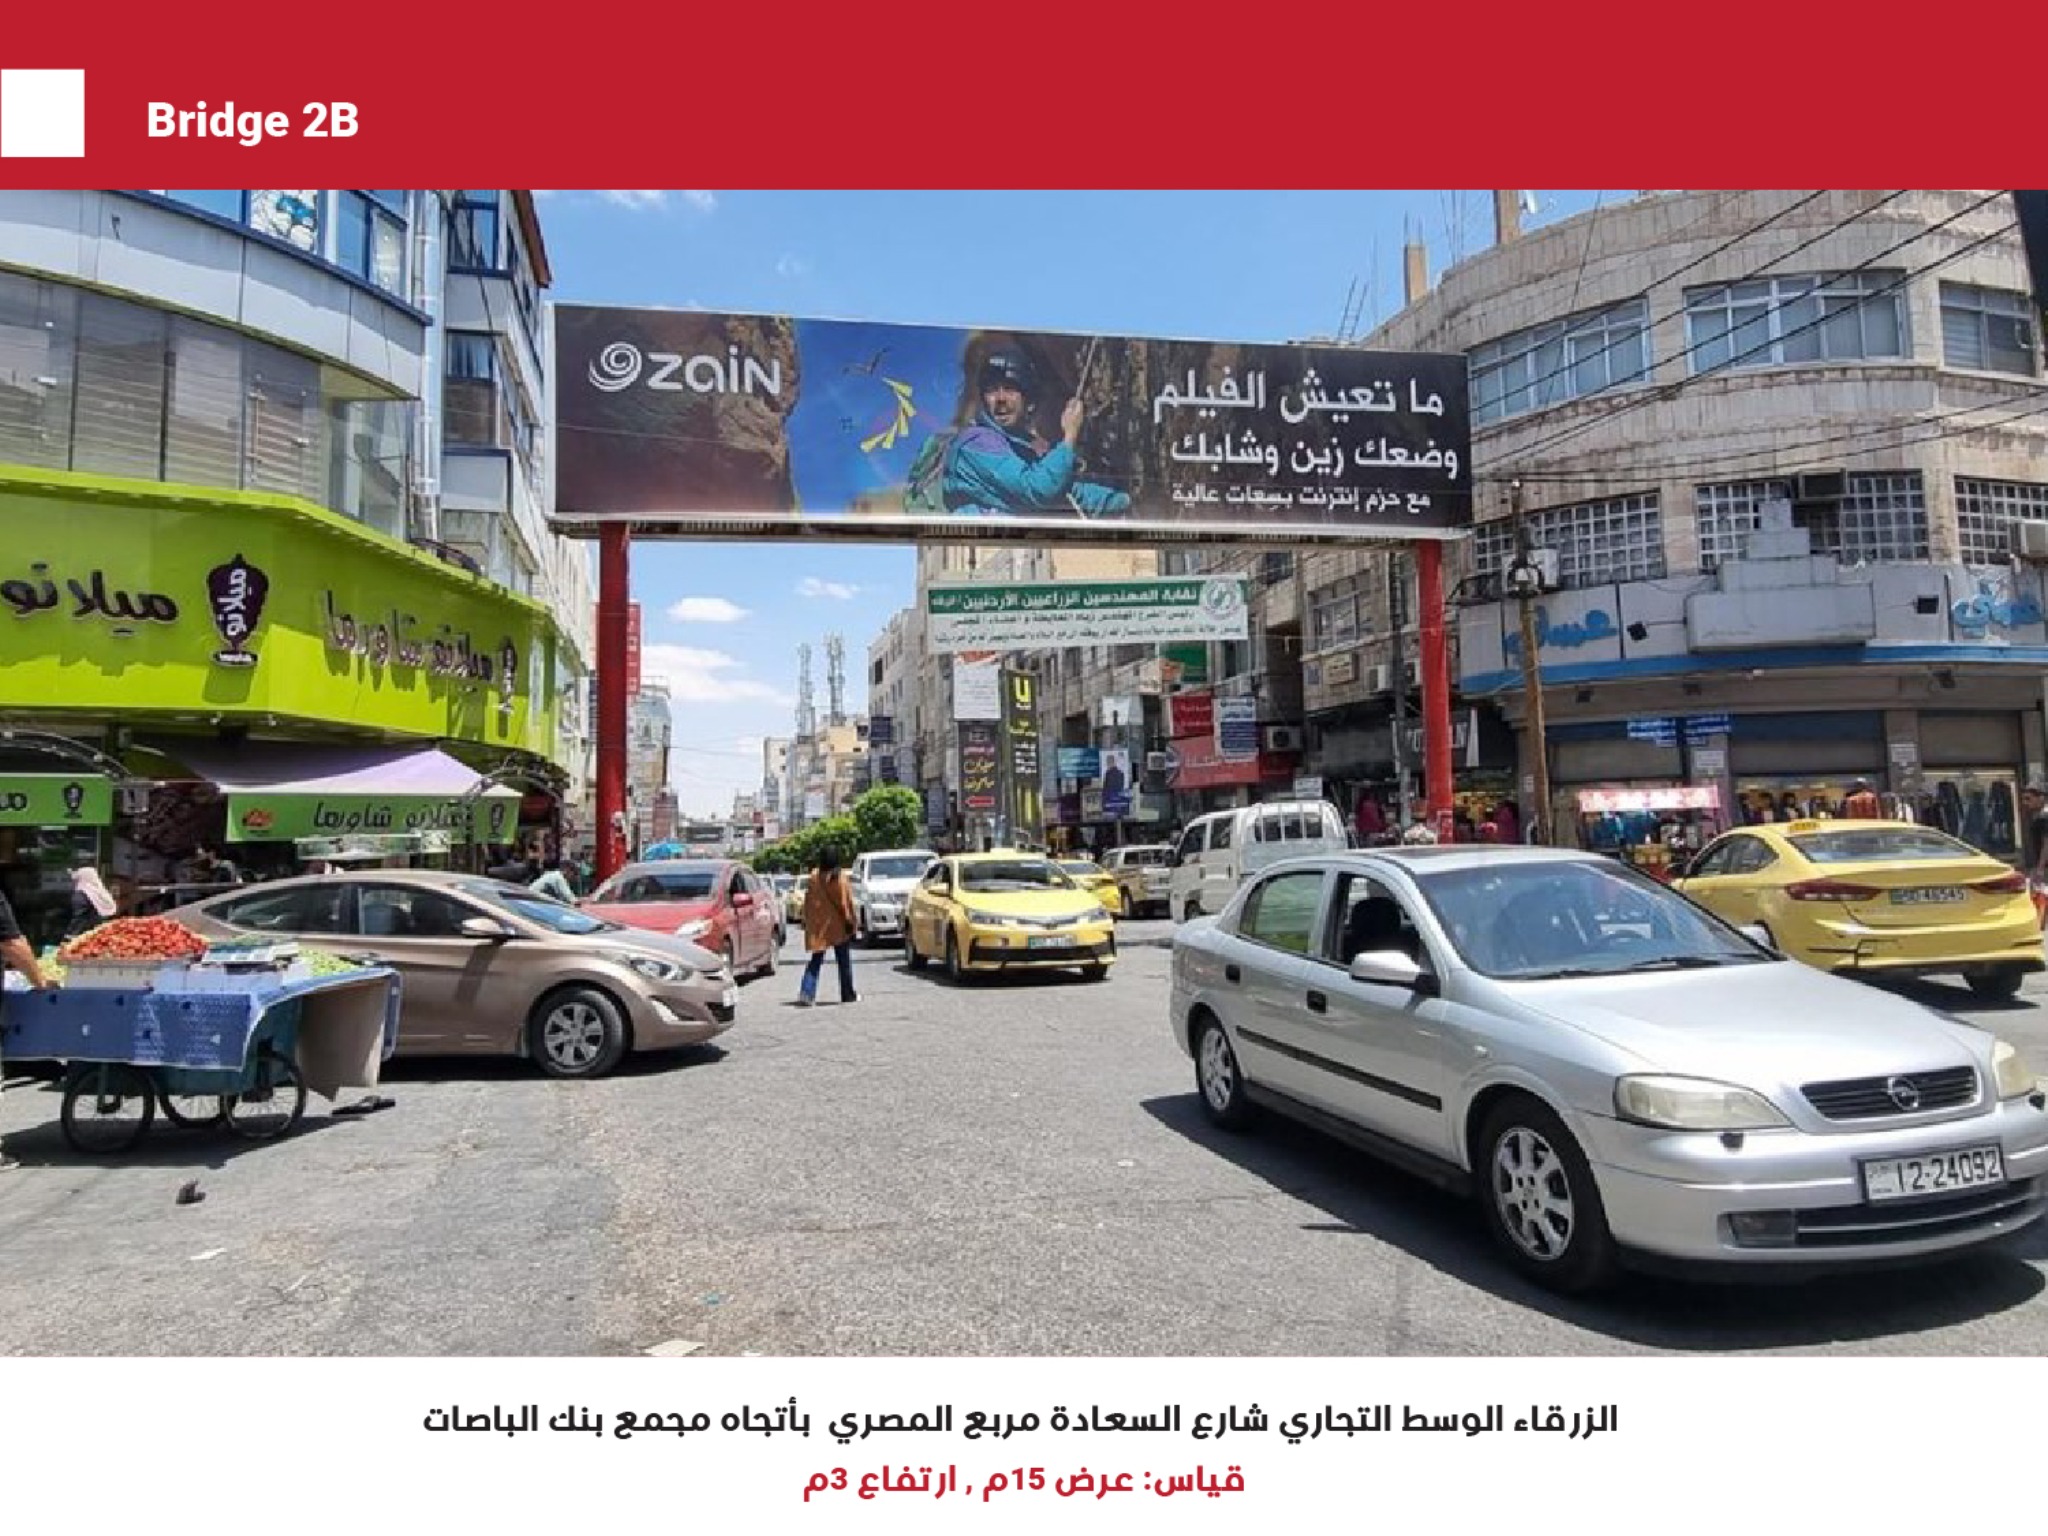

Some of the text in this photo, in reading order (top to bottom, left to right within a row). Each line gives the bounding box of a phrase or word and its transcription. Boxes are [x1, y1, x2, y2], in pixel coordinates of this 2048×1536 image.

[1154, 366, 1443, 423] ما تعيش الفيلم
[1172, 429, 1458, 479] وضعك زين وشابك
[1172, 482, 1219, 510] عالية
[1225, 483, 1294, 511] بسعات
[1366, 487, 1401, 513] حزم
[1406, 491, 1431, 513] مع
